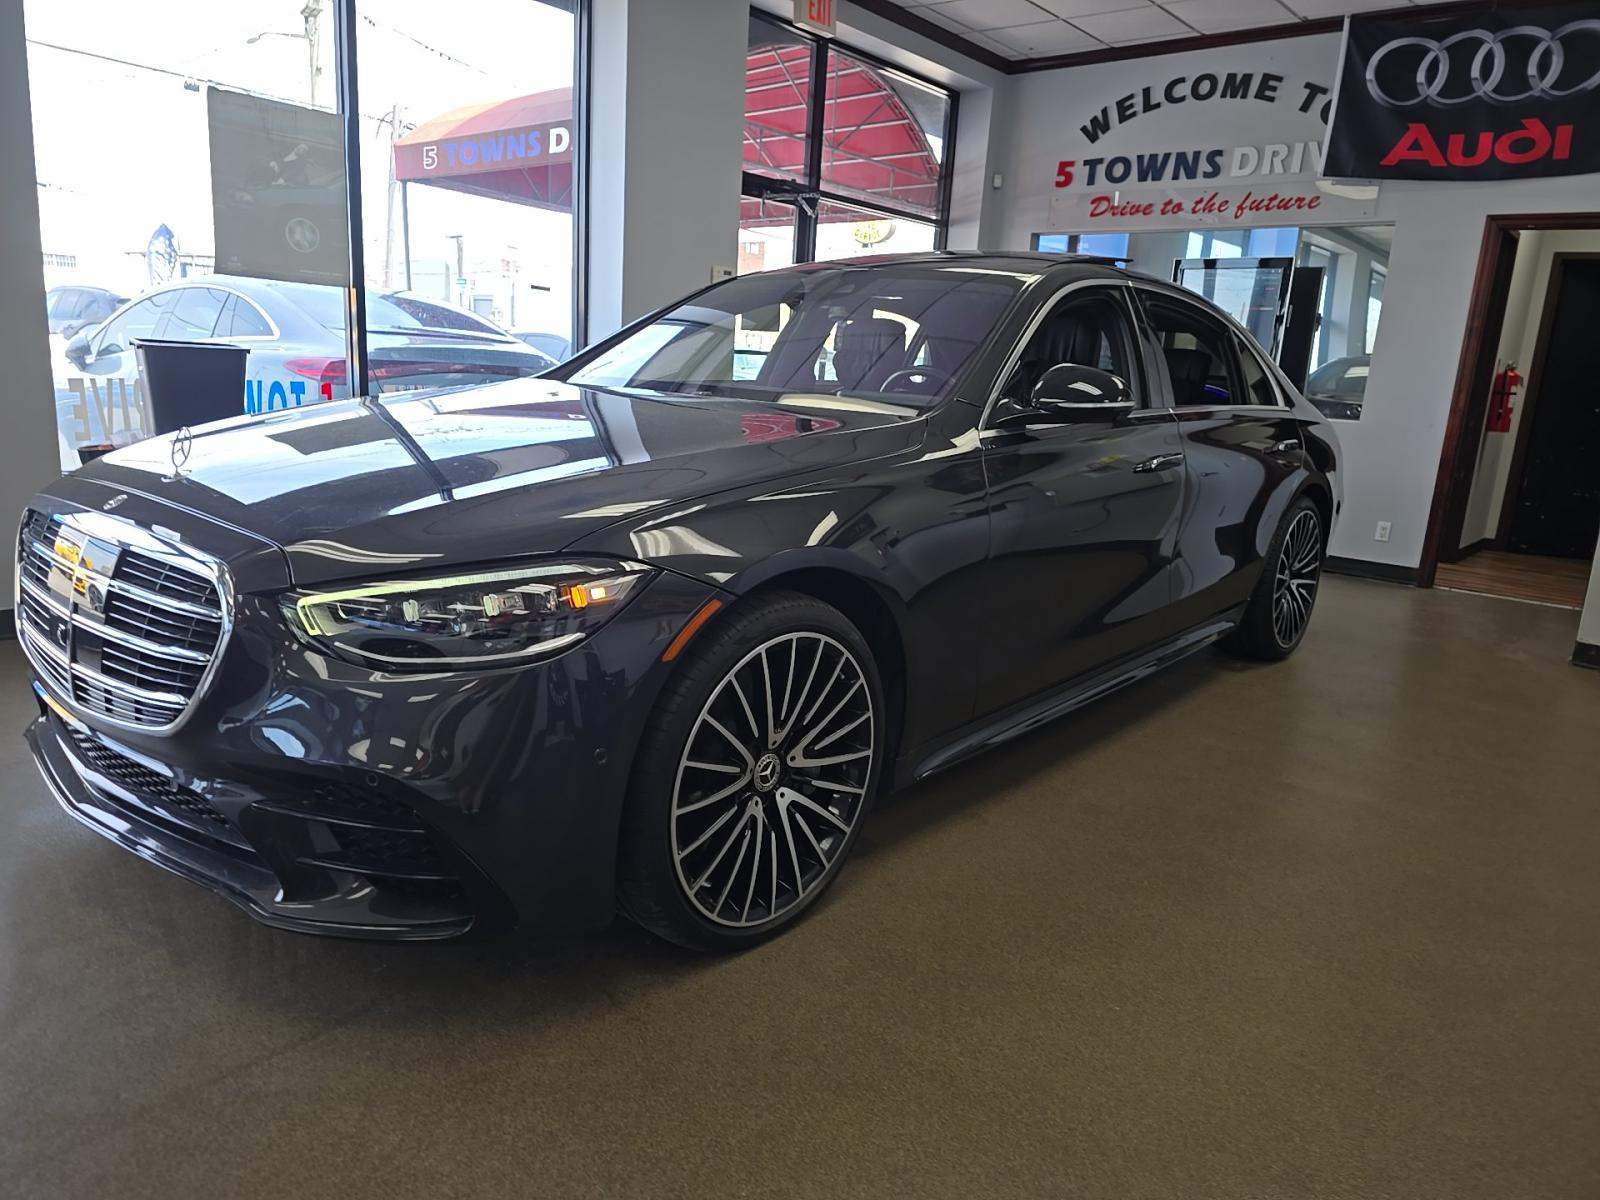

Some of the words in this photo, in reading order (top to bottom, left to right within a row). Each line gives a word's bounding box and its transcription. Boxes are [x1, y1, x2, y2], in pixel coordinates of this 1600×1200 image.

[1080, 72, 1283, 144] WELCOME
[423, 145, 438, 170] 5
[446, 131, 541, 166] TOWNS
[549, 126, 572, 154] D
[1379, 117, 1574, 168] Audi
[1055, 161, 1075, 188] 5
[1083, 149, 1224, 187] TOWNS
[1089, 195, 1153, 219] Drive
[1160, 196, 1184, 216] to
[1191, 192, 1229, 215] the
[1234, 191, 1321, 220] future
